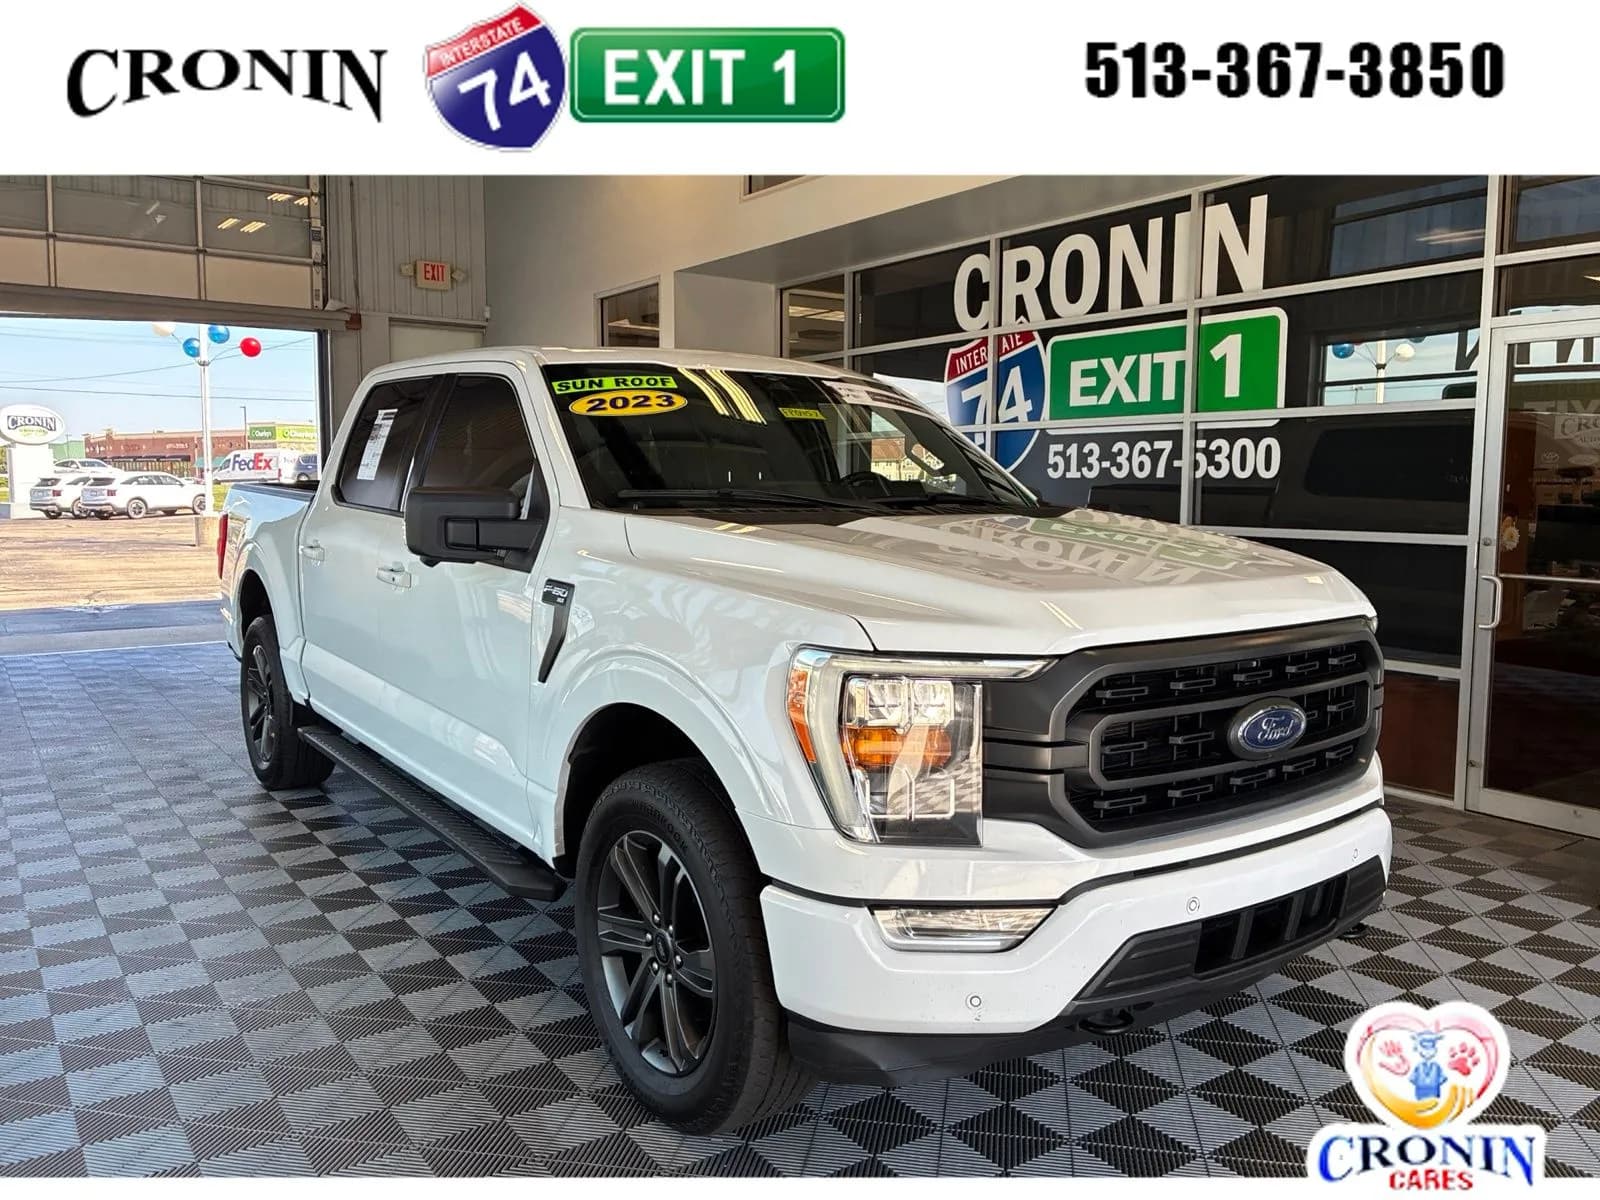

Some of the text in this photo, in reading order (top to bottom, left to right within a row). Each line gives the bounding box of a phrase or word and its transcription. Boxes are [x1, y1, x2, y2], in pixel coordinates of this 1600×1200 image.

[424, 263, 446, 281] EXIT
[953, 194, 1268, 332] CRONIN
[955, 332, 1024, 374] INTERATE
[1069, 333, 1242, 407] EXIT 1
[556, 376, 673, 392] SUN ROOF
[586, 395, 676, 413] 2023
[961, 365, 1033, 445] 74
[7, 416, 56, 431] CRONIN
[232, 453, 272, 471] FedEx
[1046, 437, 1281, 480] 513-367-5300
[1257, 716, 1294, 741] Ford
